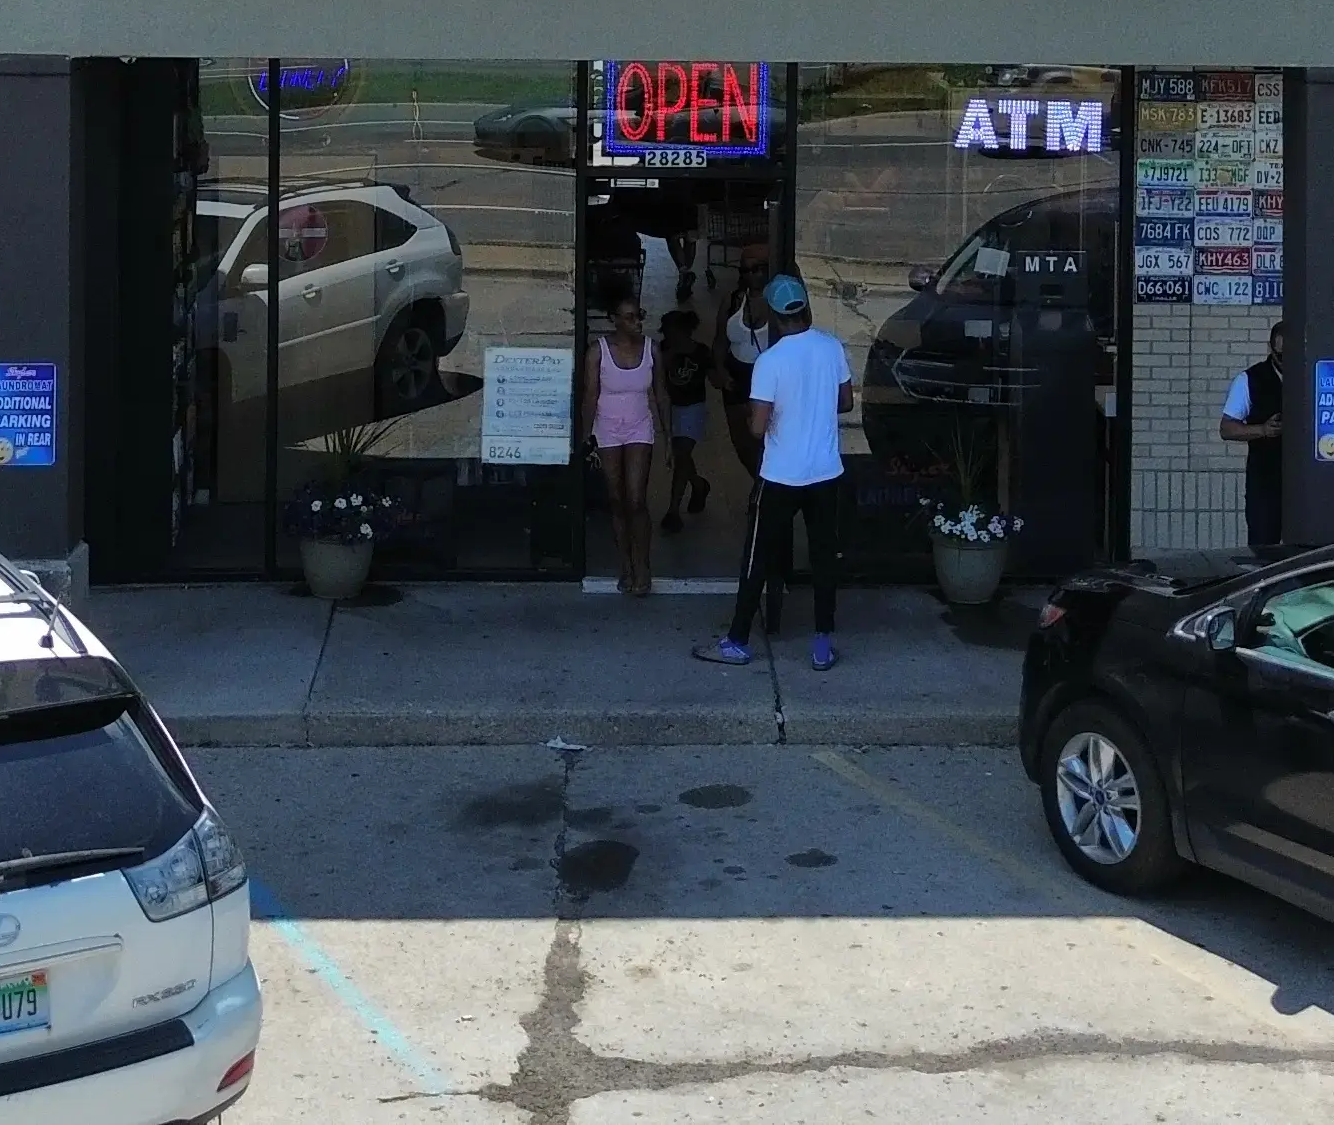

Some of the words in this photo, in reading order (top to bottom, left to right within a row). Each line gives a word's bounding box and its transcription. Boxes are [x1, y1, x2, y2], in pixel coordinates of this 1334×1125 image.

[1142, 78, 1165, 94] MJY
[1170, 78, 1194, 94] 588
[1258, 83, 1280, 96] CSS
[616, 62, 759, 142] OPEN
[954, 98, 1103, 152] ATM
[646, 151, 706, 166] 28285
[1198, 197, 1219, 212] EEU
[1222, 197, 1249, 212] 4179
[1140, 223, 1171, 238] 7684
[1174, 224, 1191, 239] FK
[1228, 227, 1250, 241] 772
[1138, 254, 1160, 269] JGX
[1167, 254, 1191, 269] 567
[1199, 253, 1249, 266] KHY463
[1196, 281, 1218, 296] CWC
[1228, 281, 1249, 296] 122
[15, 432, 25, 446] IN
[27, 432, 51, 446] REAR
[488, 446, 522, 459] 8246
[2, 988, 37, 1021] U79
